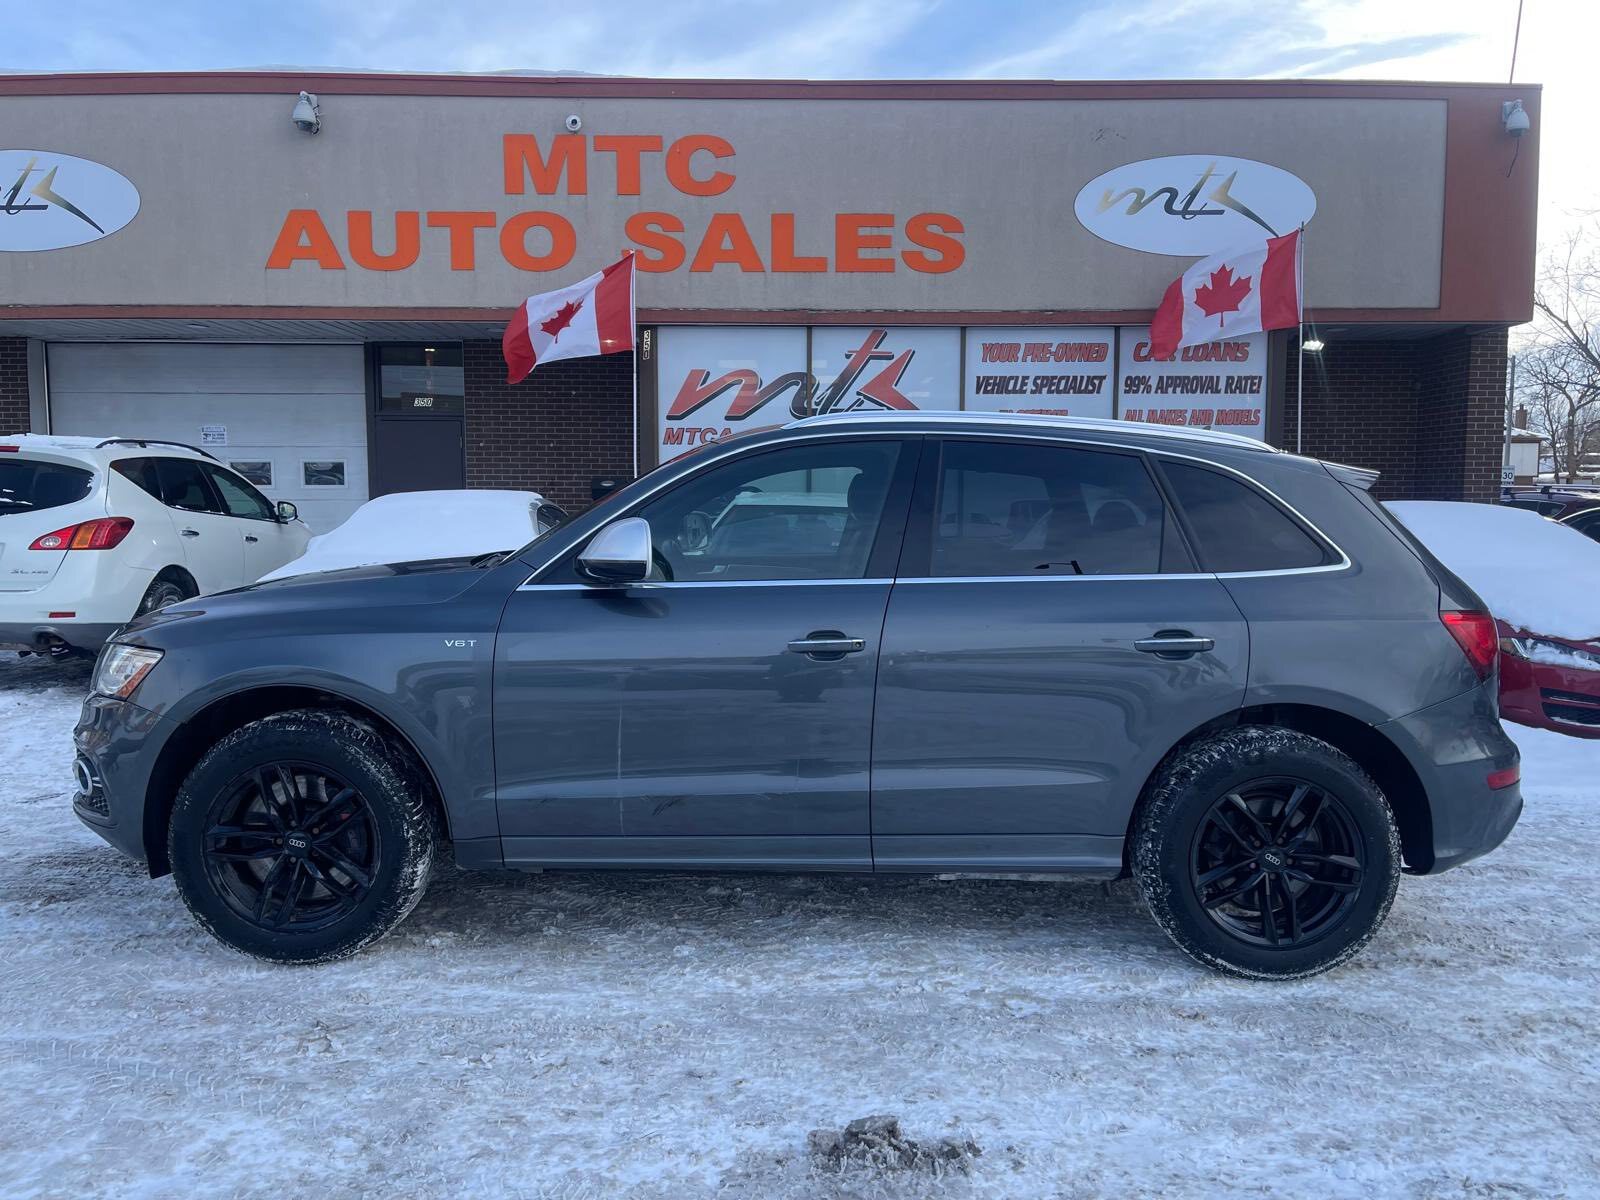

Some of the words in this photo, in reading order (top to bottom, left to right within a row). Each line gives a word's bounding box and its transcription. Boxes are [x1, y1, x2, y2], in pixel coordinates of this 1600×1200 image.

[503, 134, 736, 196] MTC
[265, 210, 577, 272] AUTO
[623, 211, 966, 274] SALES
[643, 330, 651, 360] 350
[981, 343, 1021, 363] YOUR
[1021, 342, 1109, 363] PRE-OWNED
[1181, 341, 1250, 363] LOANS
[975, 375, 1030, 395] VEHICLE
[1029, 374, 1108, 395] SPECIALIST
[1123, 375, 1152, 395] 99%
[1153, 375, 1222, 395] APPROVAL
[1223, 375, 1263, 395] RATE!
[413, 397, 433, 407] 350
[1123, 408, 1145, 423] ALL
[1145, 409, 1188, 425] MAKES
[1188, 409, 1214, 426] AND
[1215, 409, 1261, 426] MODELS
[1502, 471, 1513, 480] 30
[444, 639, 478, 647] V6T
